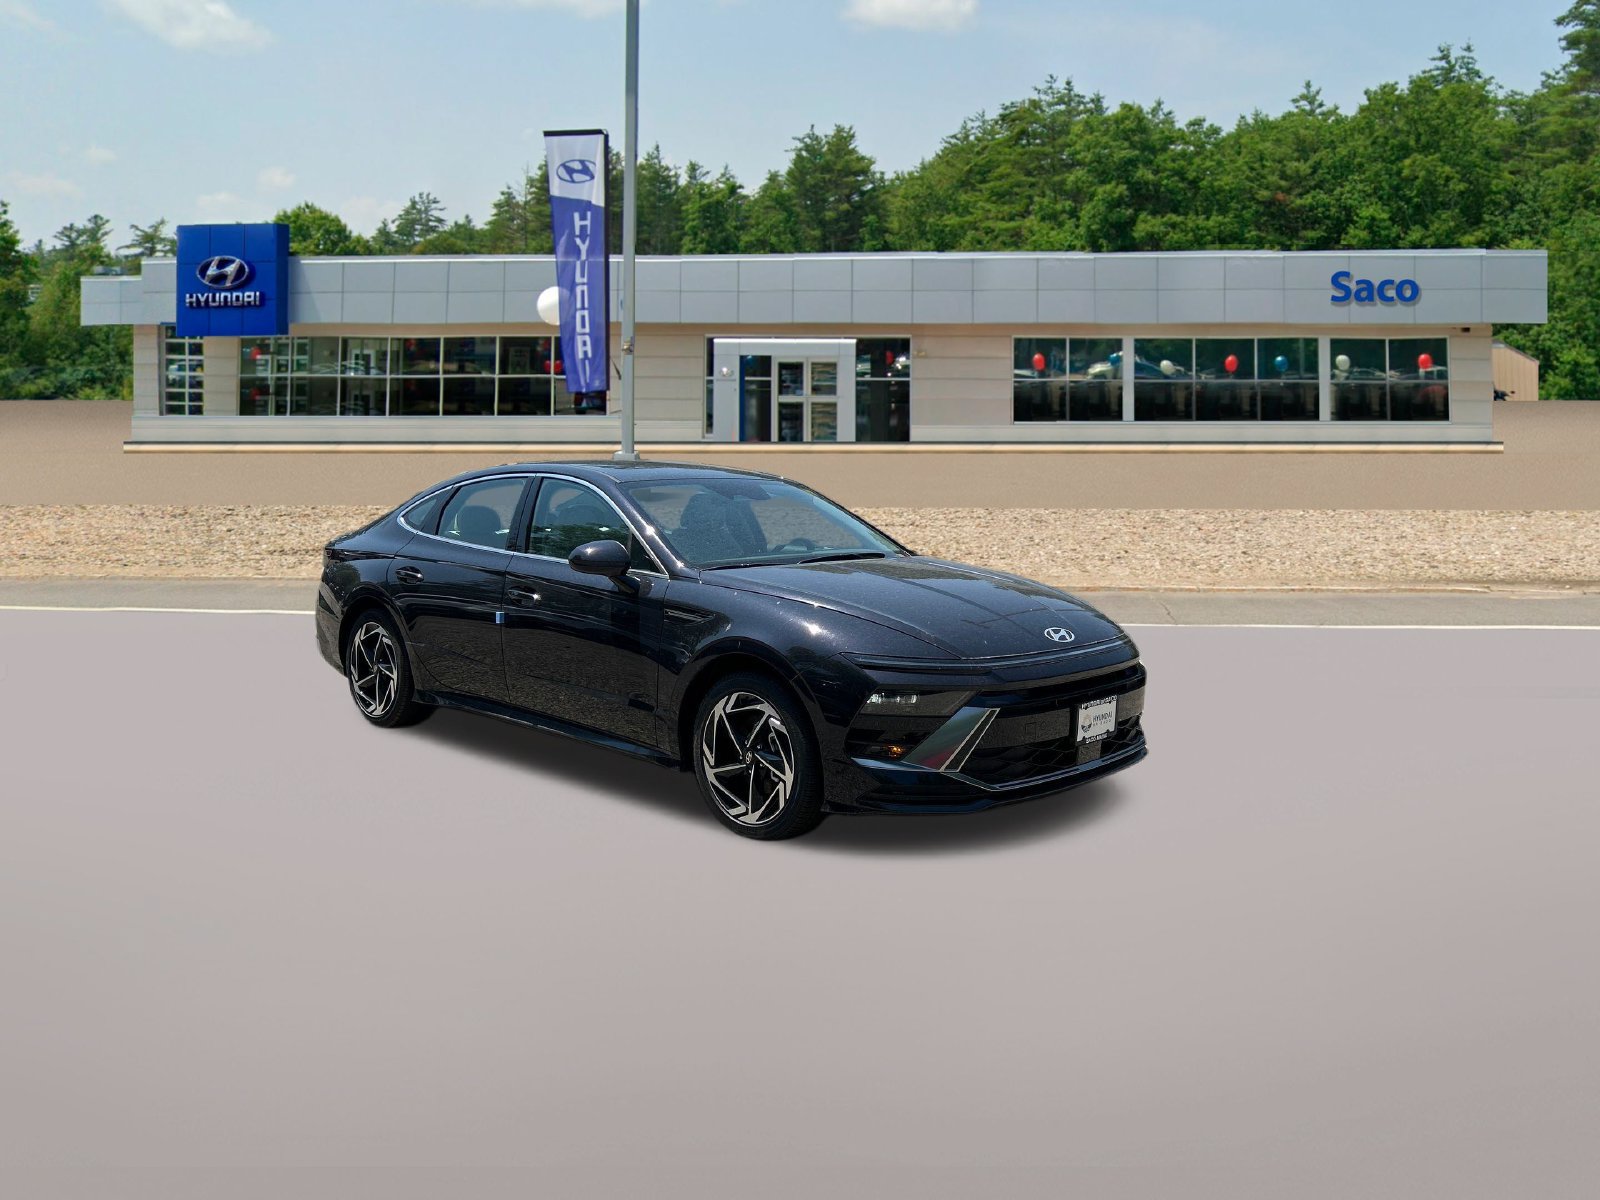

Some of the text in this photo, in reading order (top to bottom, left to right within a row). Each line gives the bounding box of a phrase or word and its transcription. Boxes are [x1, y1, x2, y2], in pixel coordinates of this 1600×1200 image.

[185, 291, 260, 307] HYUNDAI
[573, 211, 593, 383] HYUNDAI
[1330, 270, 1419, 302] Saco
